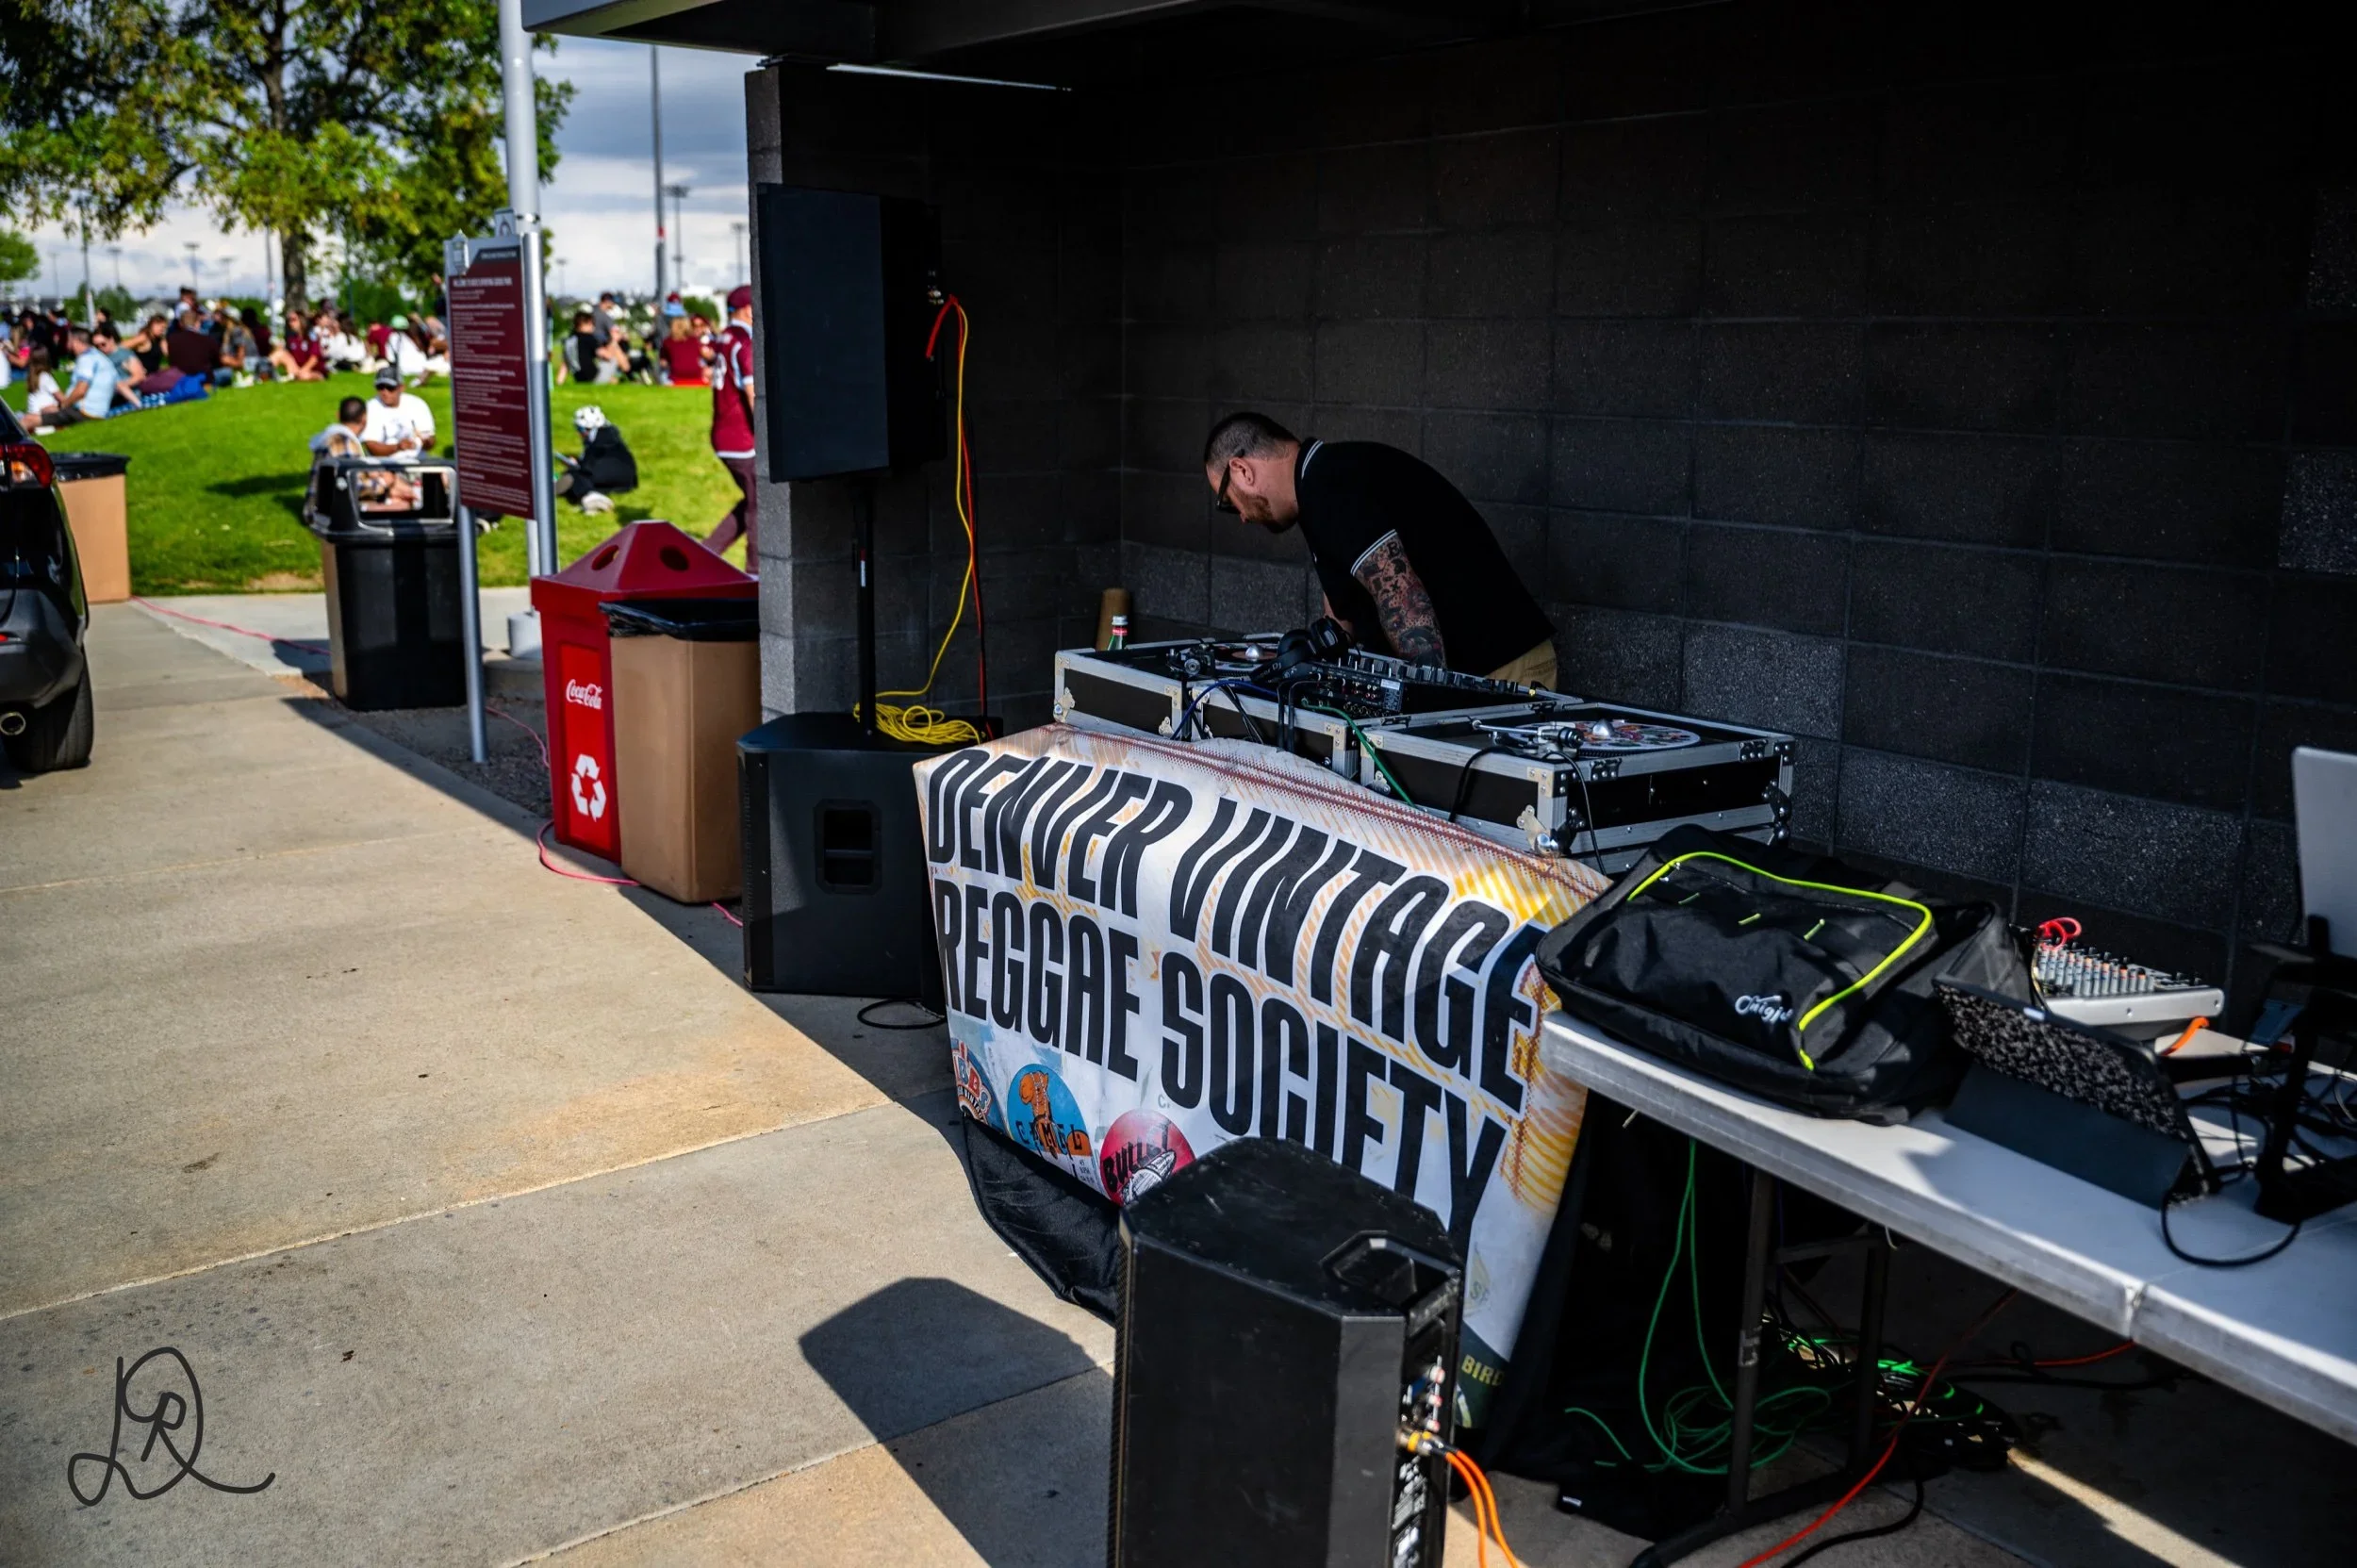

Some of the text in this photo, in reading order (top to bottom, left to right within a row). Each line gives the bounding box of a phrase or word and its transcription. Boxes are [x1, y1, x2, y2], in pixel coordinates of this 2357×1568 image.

[929, 748, 1552, 1114] DENVER VINTAGE
[933, 878, 1509, 1263] REGGAE SOCIETY
[1015, 1120, 1083, 1150] CAMEL
